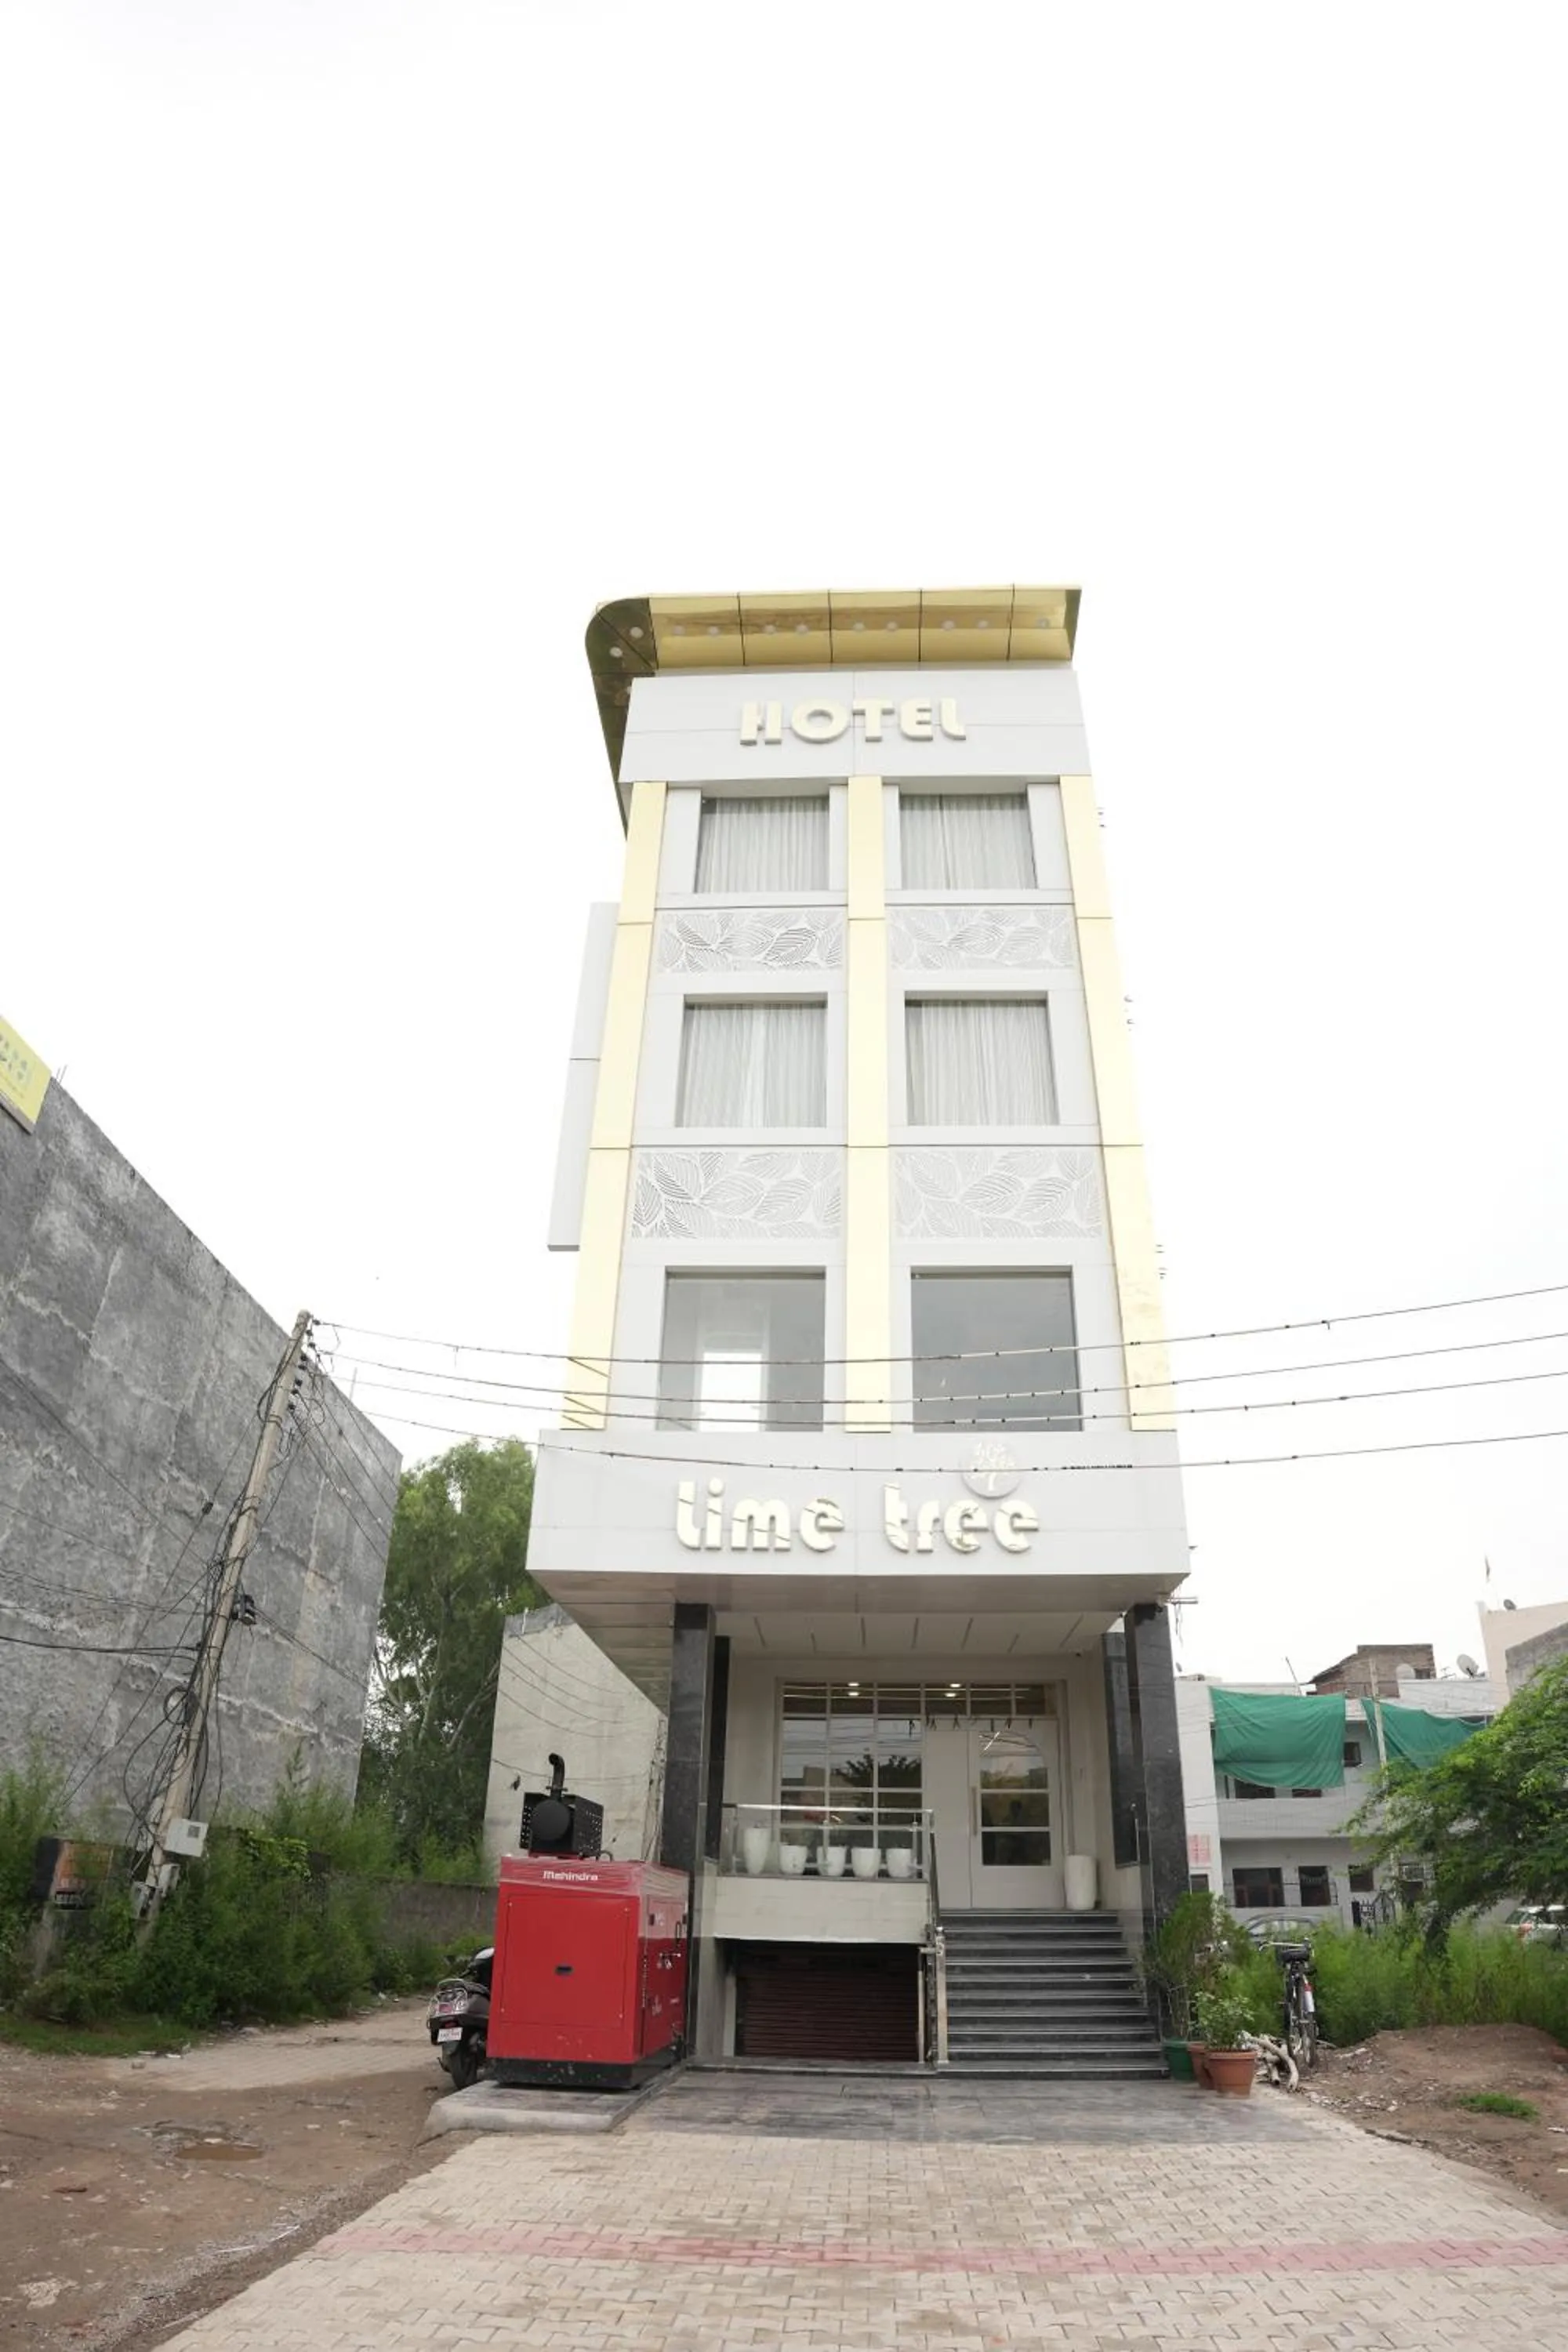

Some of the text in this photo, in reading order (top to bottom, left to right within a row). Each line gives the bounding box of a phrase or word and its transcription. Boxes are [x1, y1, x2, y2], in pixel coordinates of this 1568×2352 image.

[740, 698, 967, 746] HOTEL
[676, 1477, 1040, 1553] lime tree
[543, 1870, 598, 1881] Mahindra
